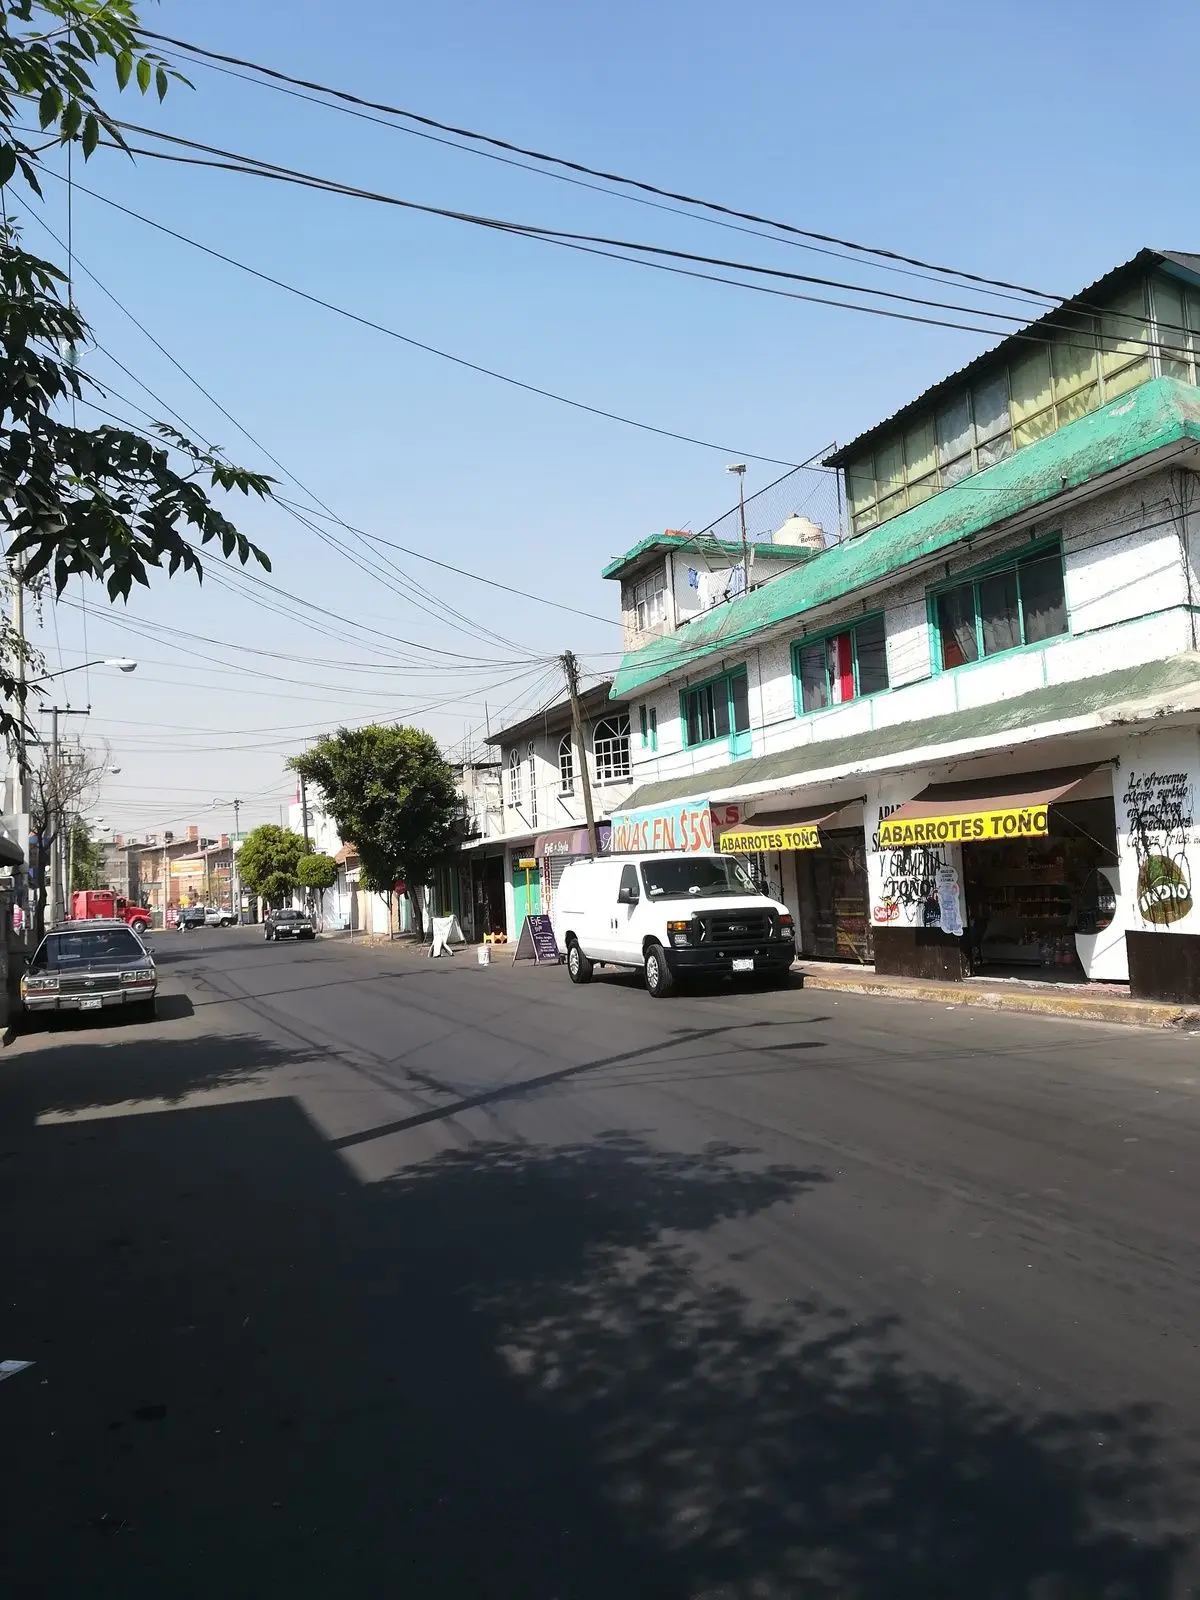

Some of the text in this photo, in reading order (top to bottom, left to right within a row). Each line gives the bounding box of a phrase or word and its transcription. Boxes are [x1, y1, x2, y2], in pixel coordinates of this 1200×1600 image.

[1157, 783, 1188, 800] surtido
[652, 817, 675, 851] EN
[680, 809, 711, 851] $50
[881, 809, 1047, 843] ABARROTES TOÑO
[1130, 814, 1192, 832] Dsechables.
[721, 828, 819, 851] ABARROTES TOÑO
[1127, 832, 1160, 848] Caes
[879, 854, 886, 877] Y
[889, 851, 940, 876] CRMERIA
